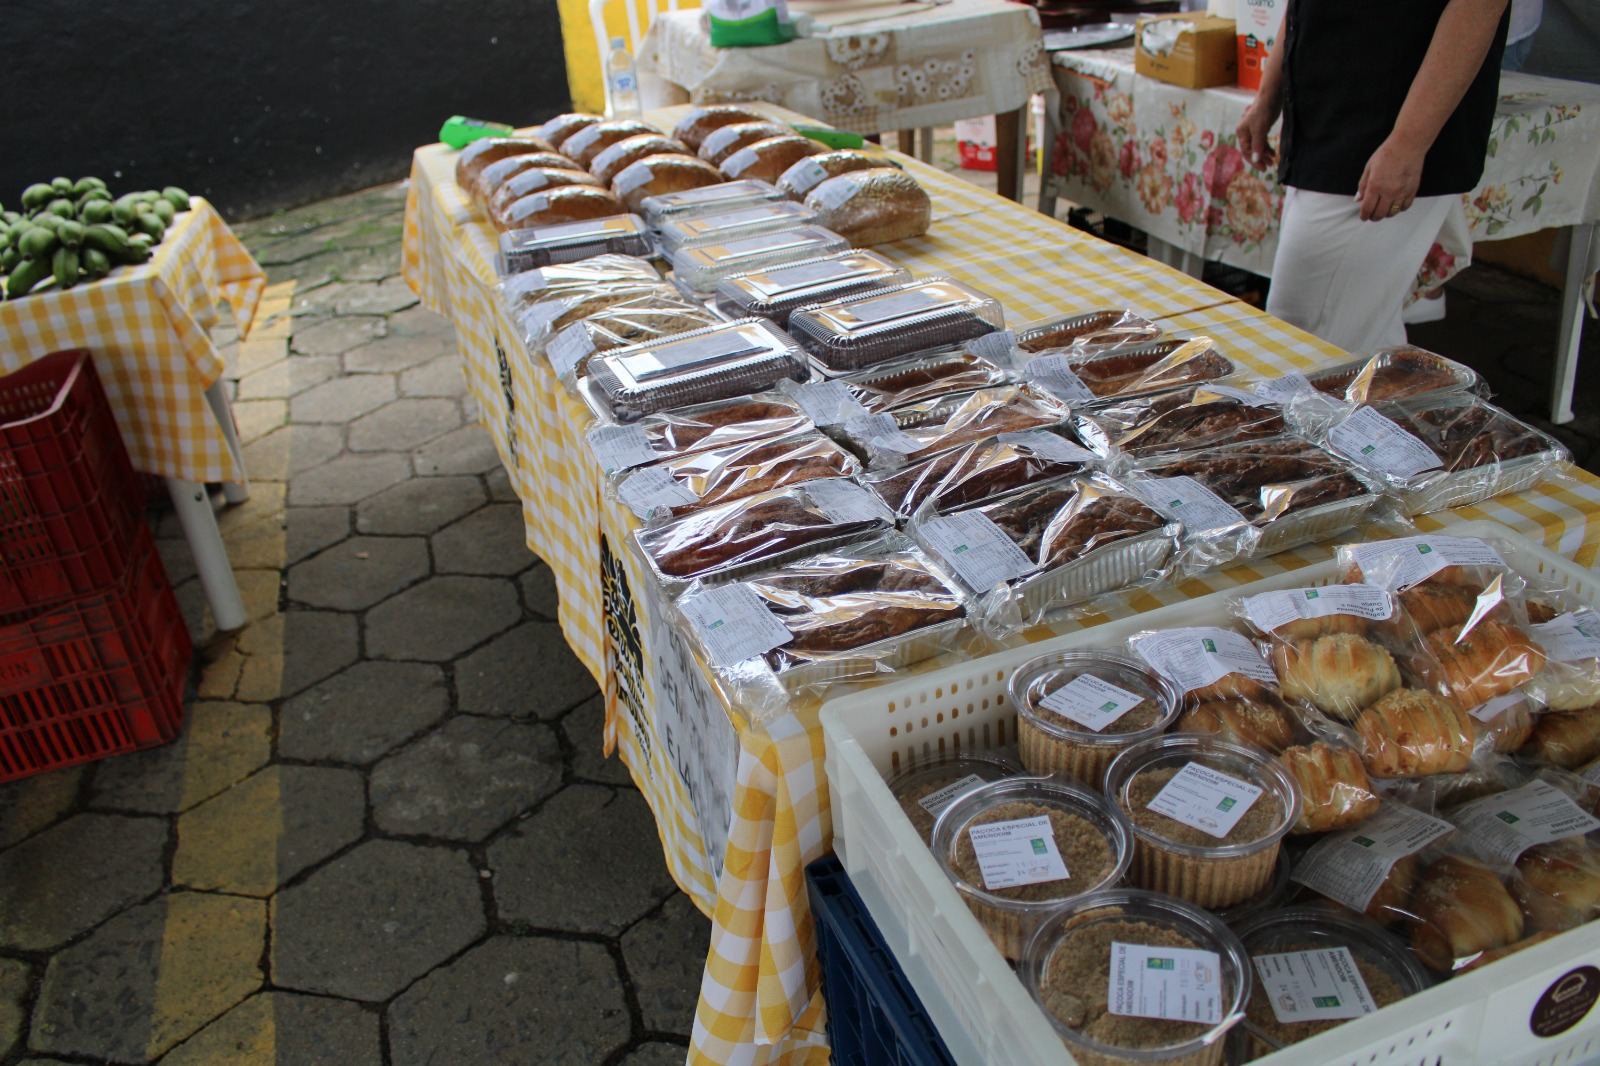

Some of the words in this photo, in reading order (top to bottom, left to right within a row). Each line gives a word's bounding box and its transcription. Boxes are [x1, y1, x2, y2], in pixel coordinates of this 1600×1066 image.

[1077, 678, 1106, 693] AMENDOIM
[1104, 685, 1128, 698] ESPECIAL
[1183, 769, 1219, 786] AMENDOIM
[1187, 765, 1214, 778] PAÇOCA
[1215, 775, 1246, 791] ESPECIAL
[944, 781, 970, 795] ESPECIAL
[925, 794, 955, 810] AMENDOIM
[971, 827, 1001, 835] PAÇOCA
[1002, 822, 1037, 831] ESPECIAL
[973, 831, 1012, 840] AMENDOIM
[1118, 945, 1126, 954] DE
[1117, 956, 1126, 986] ESPECIAL
[1329, 951, 1347, 983] AMENDOIM
[1337, 950, 1352, 974] PAÇOCA
[1348, 975, 1364, 1003] ESPECIAL
[1362, 1005, 1370, 1014] DE
[1116, 987, 1125, 1014] PAÇOCA
